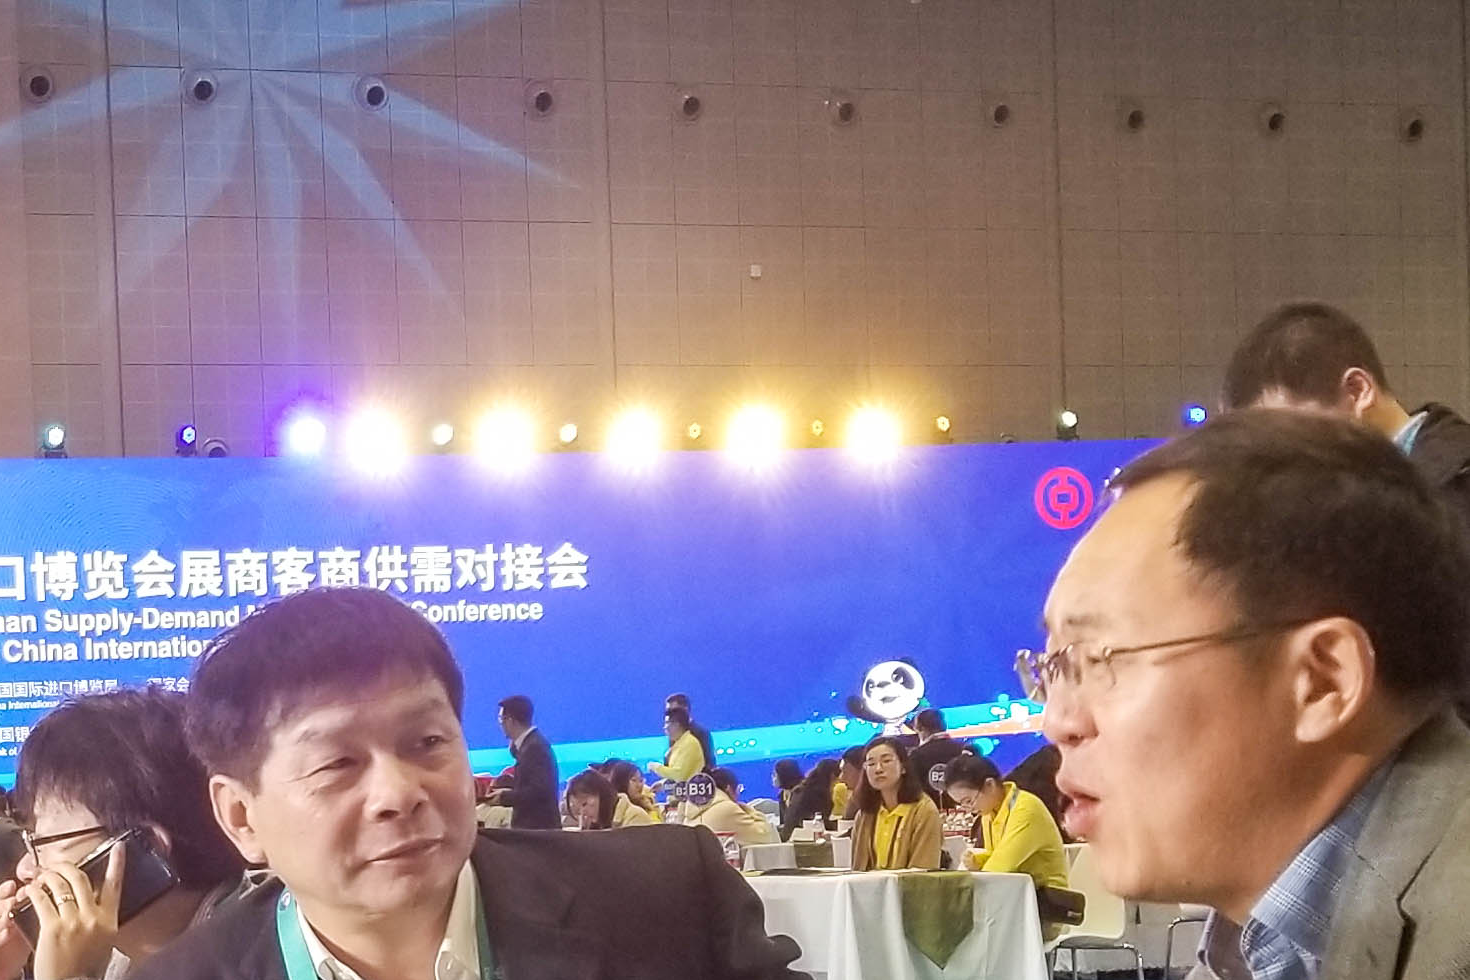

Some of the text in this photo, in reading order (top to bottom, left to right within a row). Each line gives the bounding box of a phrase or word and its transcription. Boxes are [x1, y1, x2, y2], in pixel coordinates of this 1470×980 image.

[45, 604, 241, 637] Supply-Demand
[411, 599, 544, 623] Conference
[2, 637, 79, 663] China
[85, 634, 215, 661] Internatio
[689, 783, 713, 796] B31
